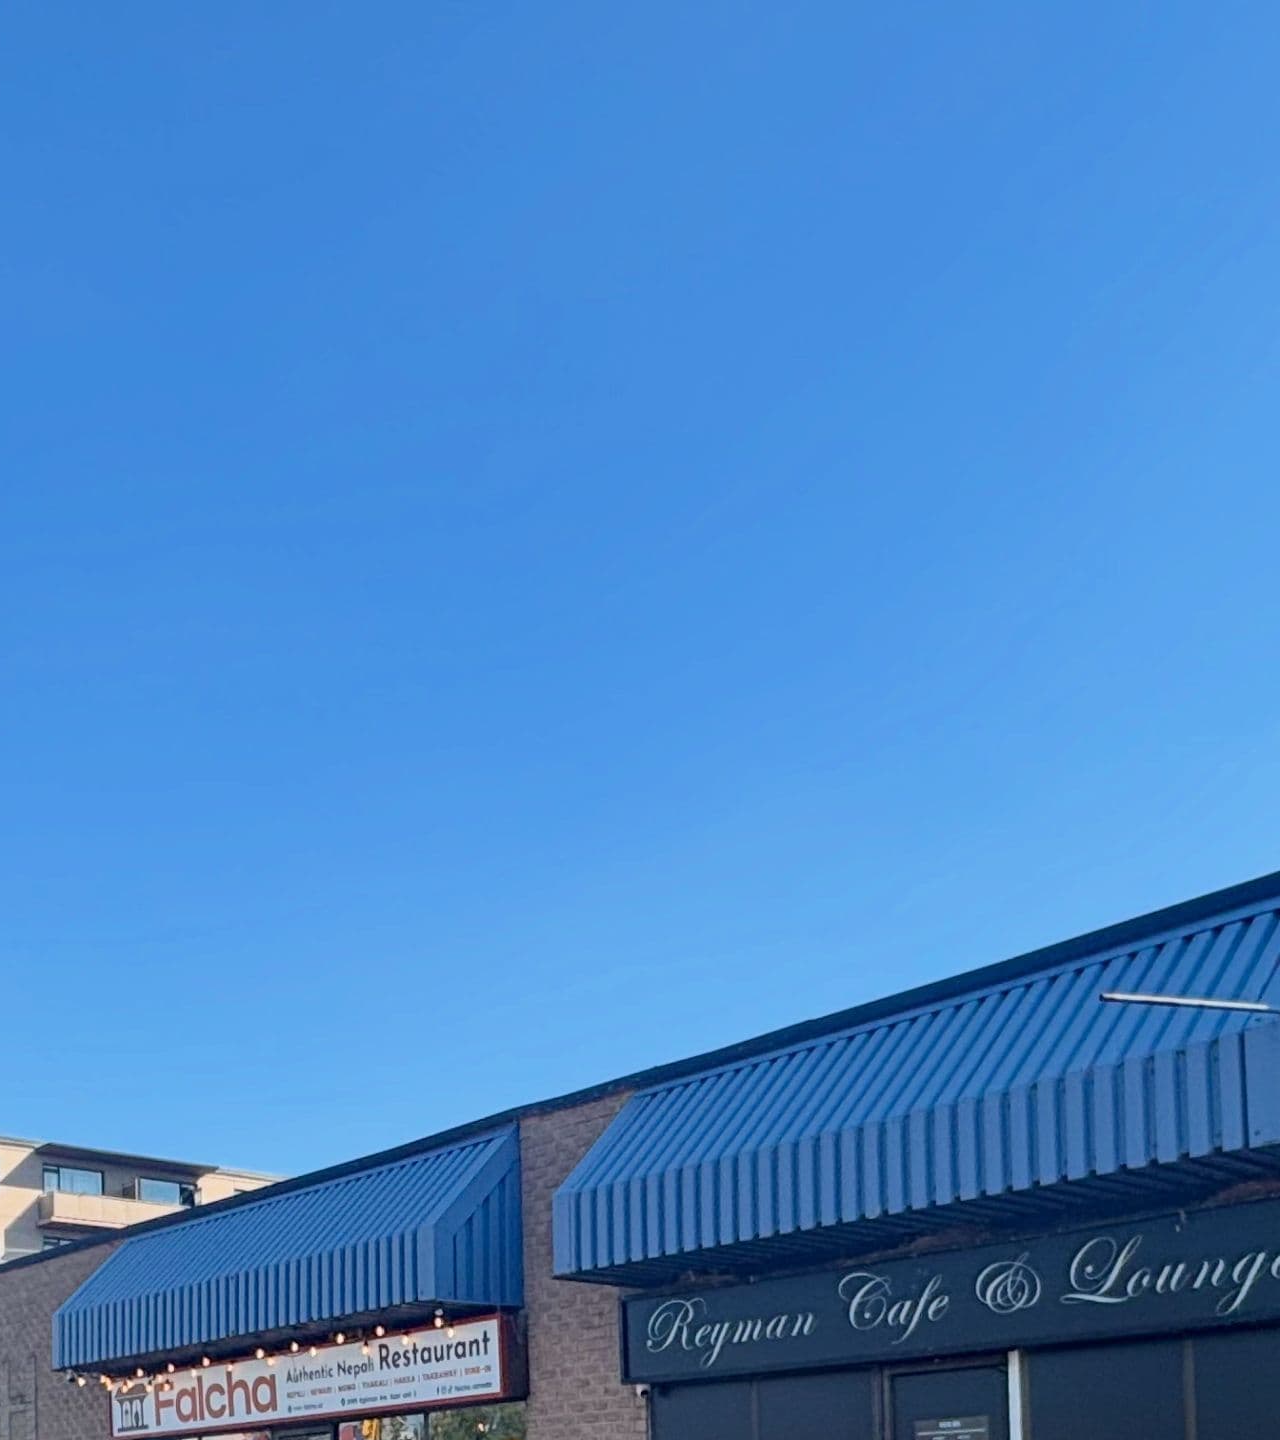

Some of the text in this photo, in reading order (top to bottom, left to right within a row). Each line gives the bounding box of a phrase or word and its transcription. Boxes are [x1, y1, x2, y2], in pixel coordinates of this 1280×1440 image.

[646, 1298, 816, 1369] Reyman
[839, 1272, 950, 1344] Cafe
[975, 1252, 1042, 1313] &
[154, 1330, 490, 1427] Falcha Authentic Nepali Restaurant
